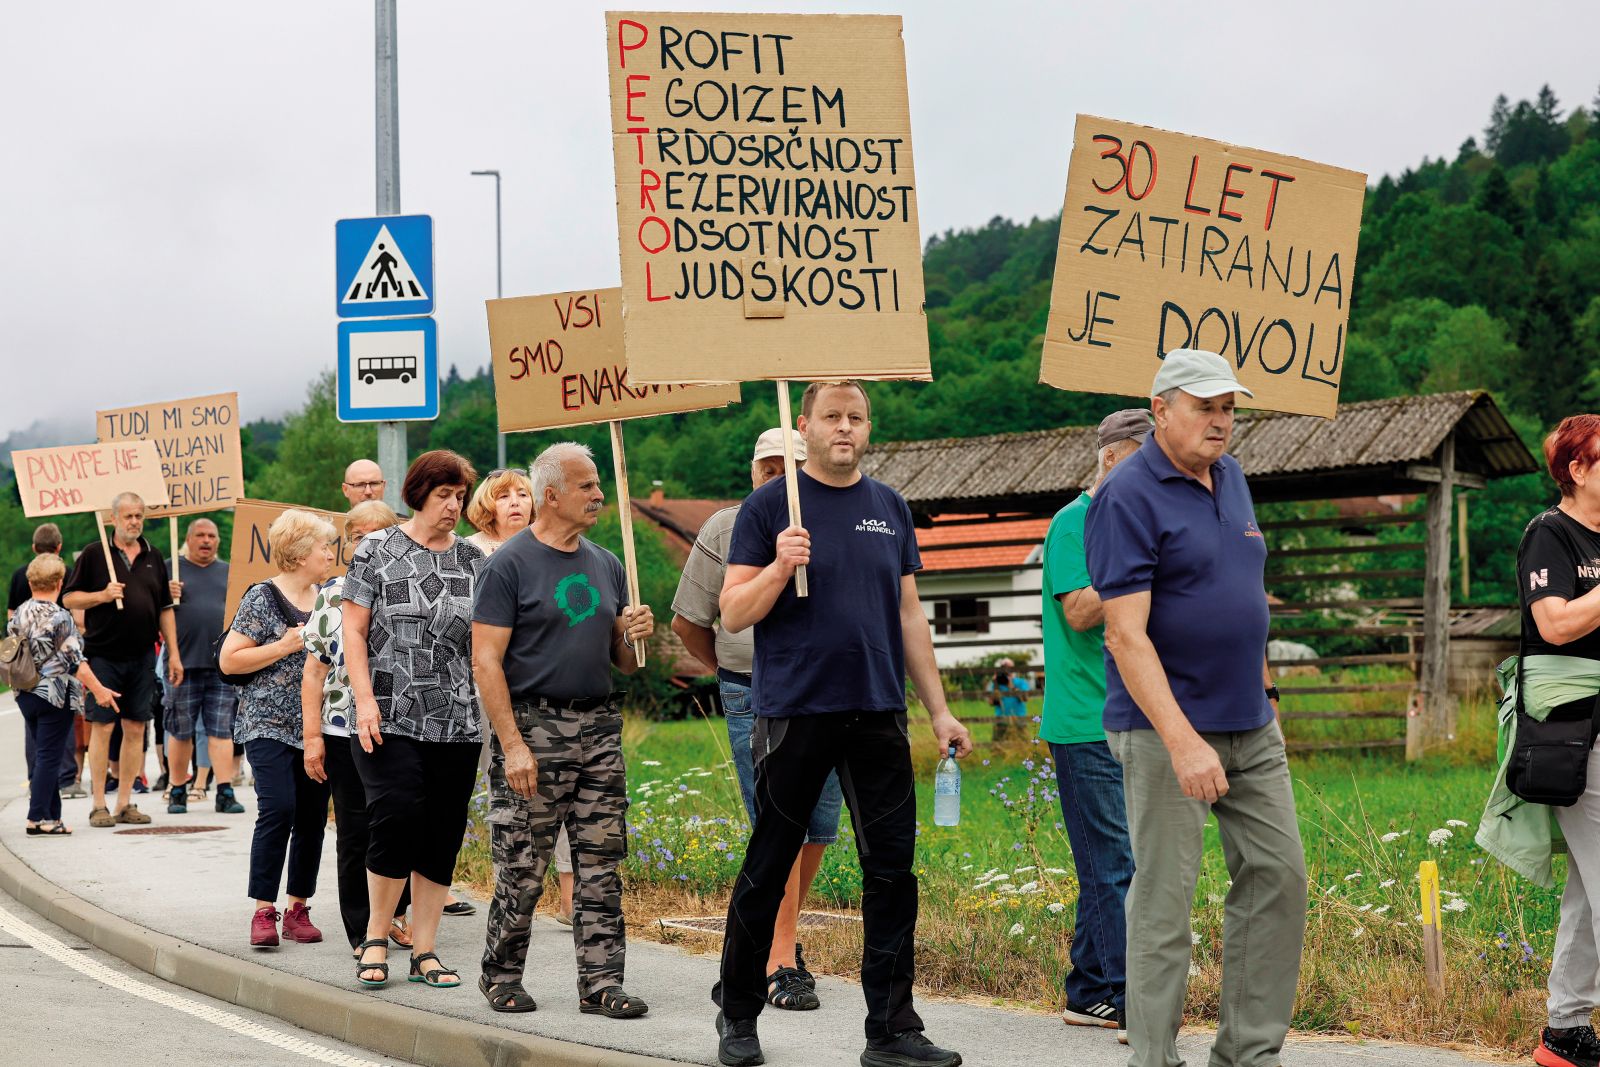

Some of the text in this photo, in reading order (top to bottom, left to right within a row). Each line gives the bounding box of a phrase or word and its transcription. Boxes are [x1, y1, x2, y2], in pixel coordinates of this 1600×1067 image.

[618, 20, 793, 75] PROFIT
[626, 74, 846, 128] EGOIZEM
[627, 126, 903, 175] TRDOSRČNOST
[640, 169, 914, 222] REZERVIRANOST
[1092, 134, 1296, 231] 30 LET
[638, 215, 880, 263] ODSOTNOST
[1080, 205, 1343, 310] ZATIRANJA
[646, 260, 900, 312] LJUDSKOSTI
[553, 294, 602, 331] VSI
[509, 339, 564, 380] SMO
[1067, 290, 1343, 389] JE DOVOLJ
[104, 405, 232, 438] TUDI MI SMO
[26, 449, 142, 489] PUMPE NE
[161, 459, 207, 478] BLIKE
[1530, 568, 1548, 591] N
